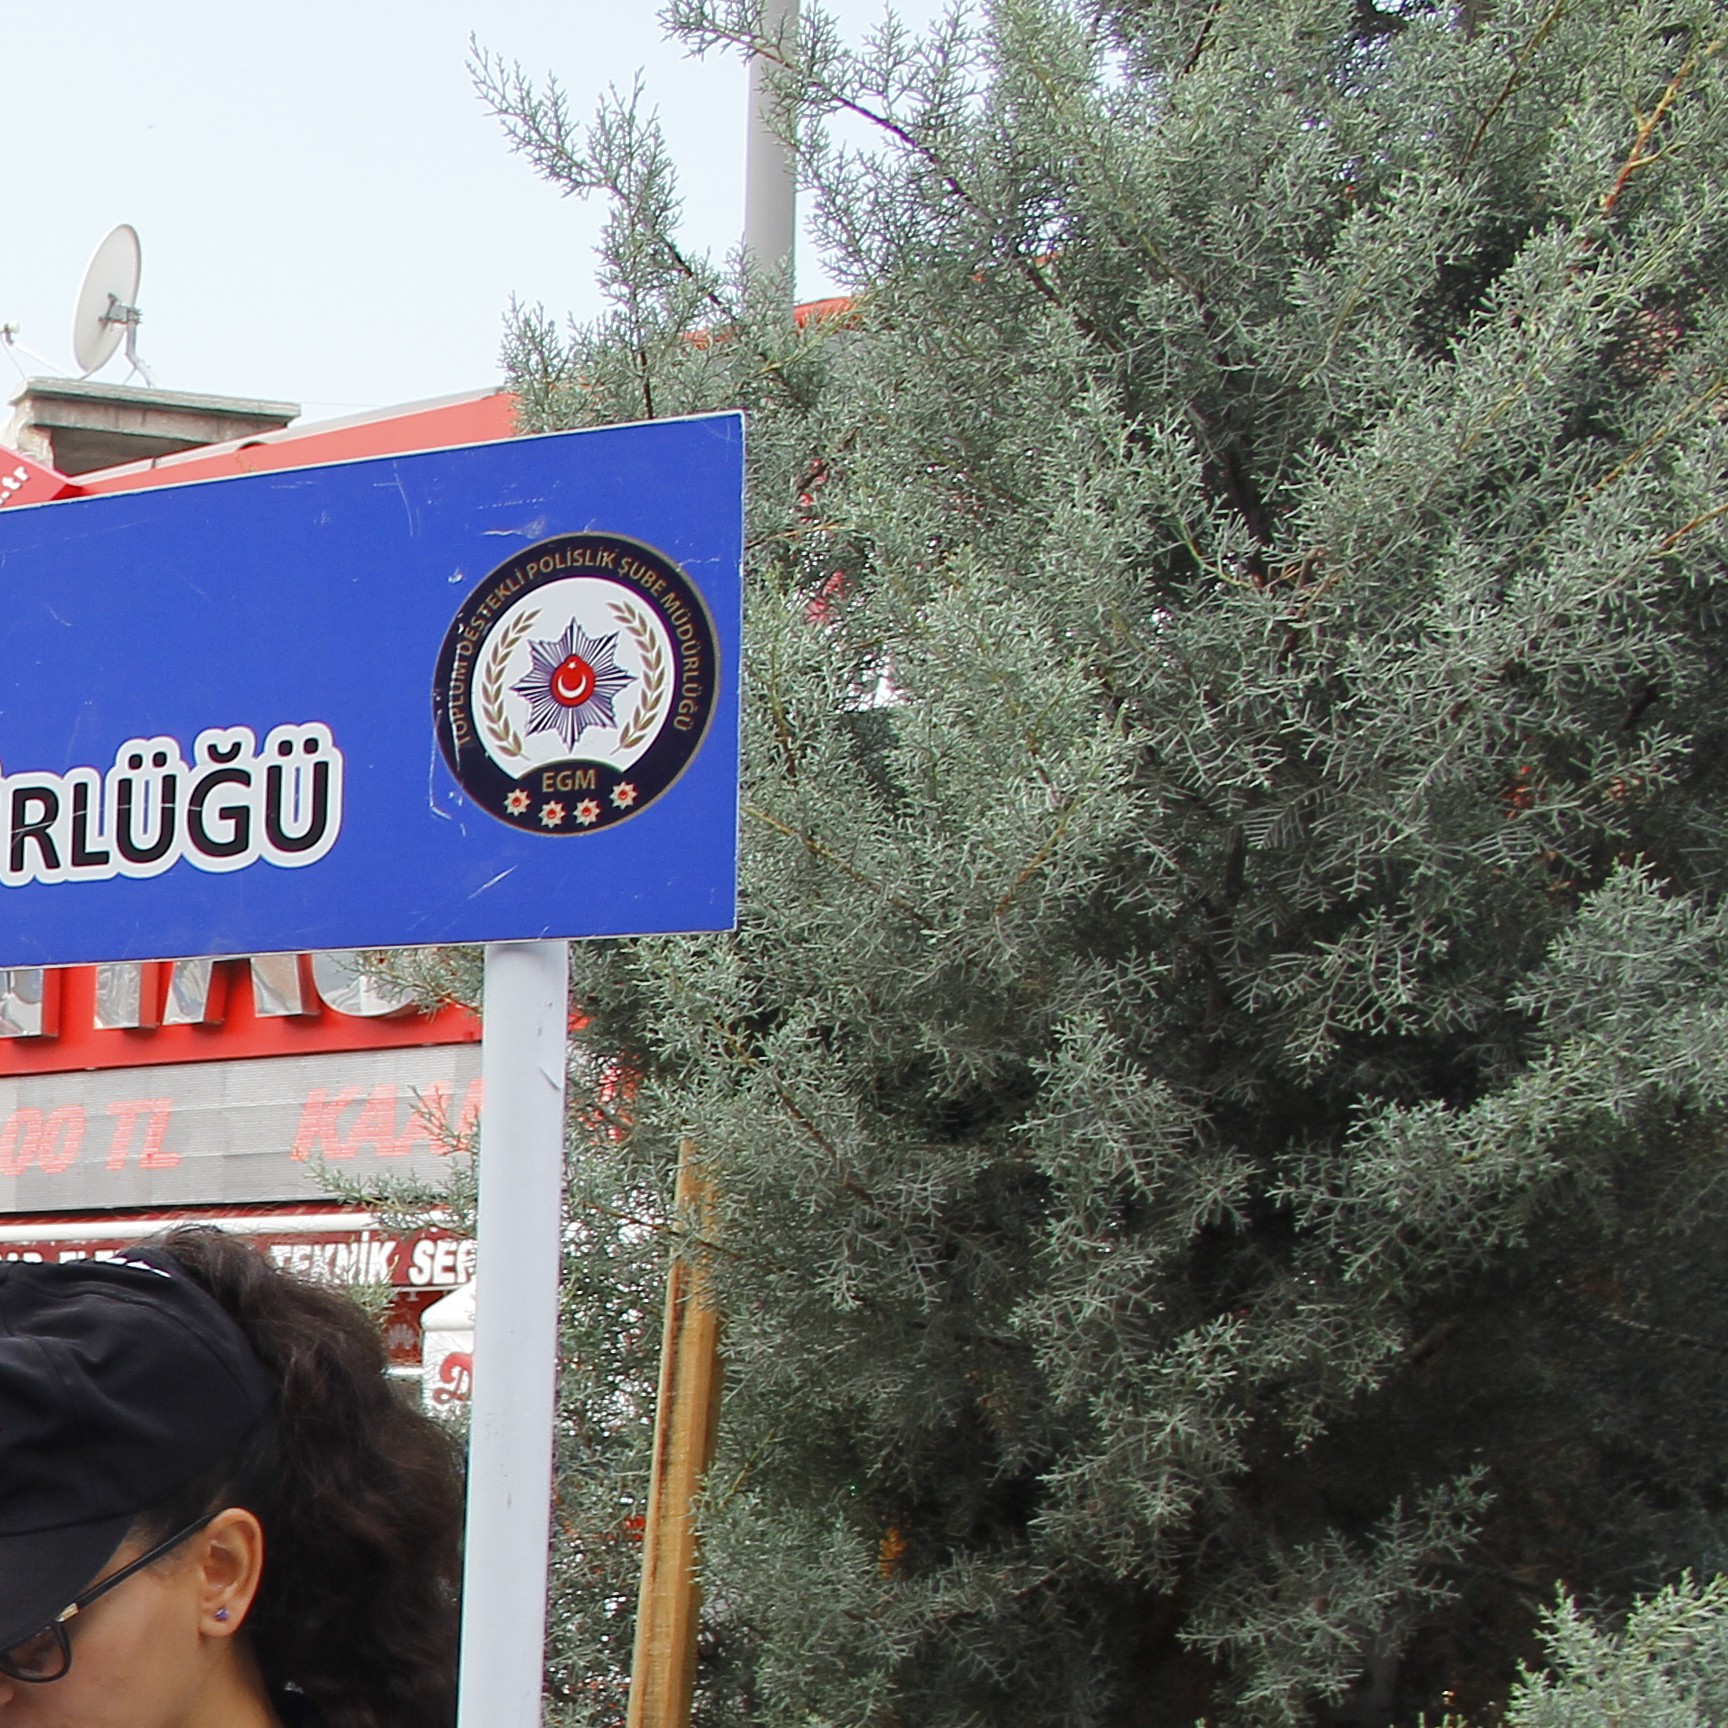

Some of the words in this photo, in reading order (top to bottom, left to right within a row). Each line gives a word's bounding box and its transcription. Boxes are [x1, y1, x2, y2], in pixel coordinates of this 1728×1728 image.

[620, 556, 666, 597] ŞUBE
[542, 769, 596, 792] EGM
[105, 1097, 181, 1171] TL
